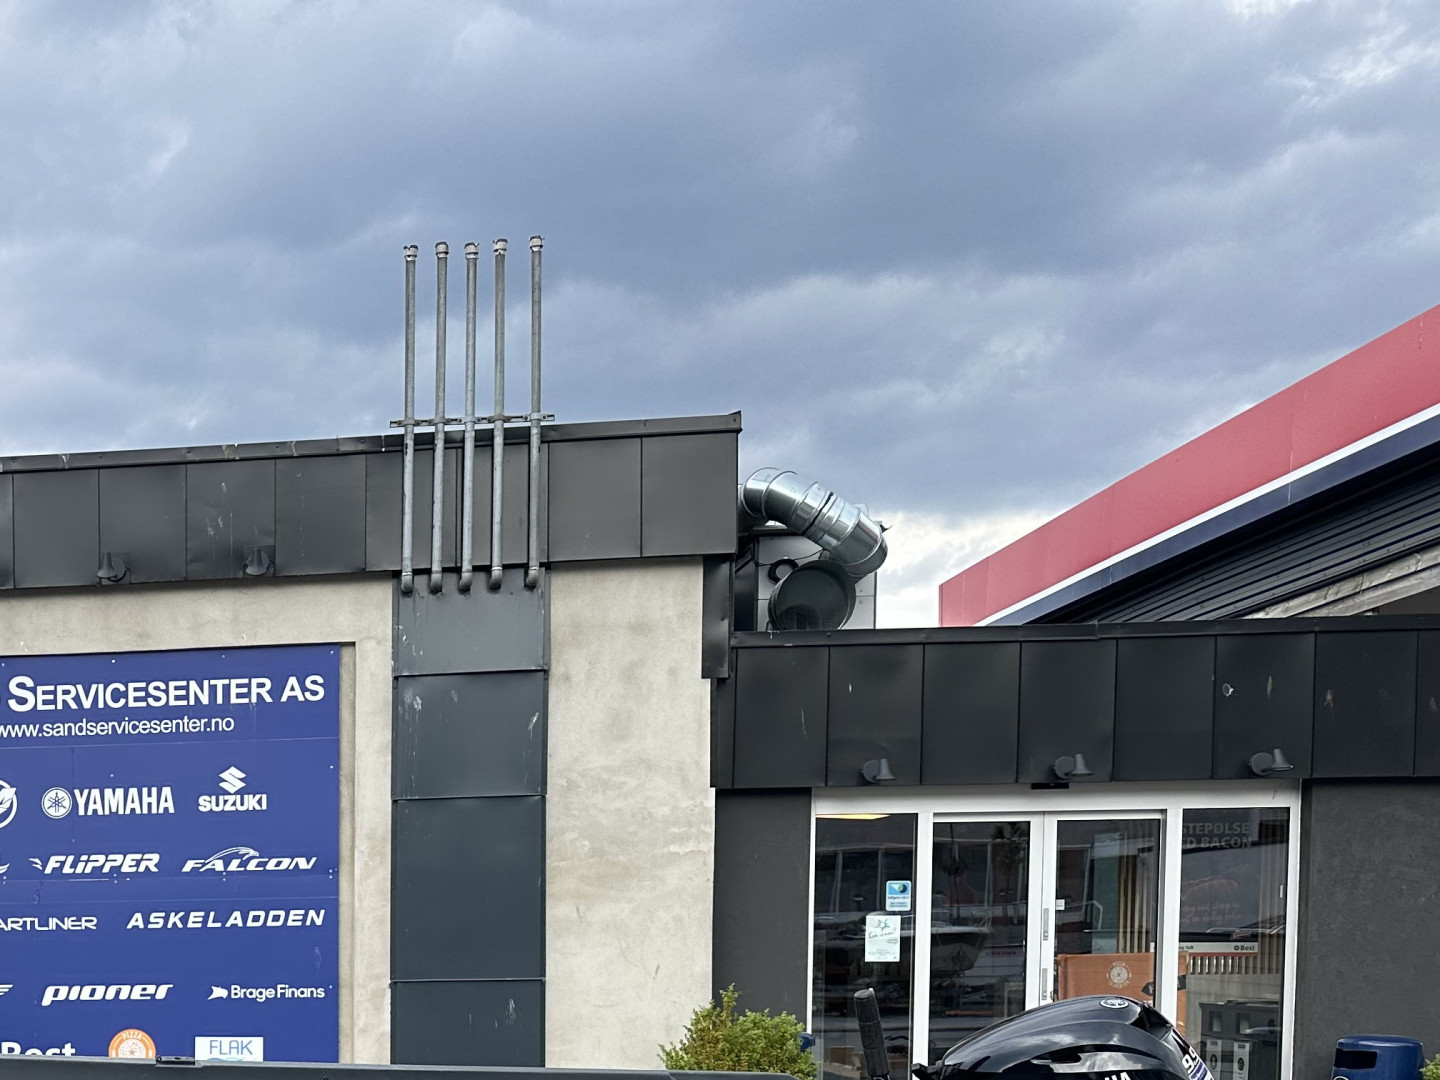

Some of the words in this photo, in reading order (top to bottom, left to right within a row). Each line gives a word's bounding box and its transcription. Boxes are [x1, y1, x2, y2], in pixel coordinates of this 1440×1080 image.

[8, 675, 273, 712] SERVICESENTER
[280, 674, 325, 702] AS
[74, 786, 175, 816] YAMAHA
[198, 793, 267, 812] SUZUKI
[182, 854, 317, 873] FALCON
[126, 909, 325, 929] ASKELADDEN
[41, 984, 174, 1007] pioner
[121, 1031, 142, 1040] PIZZA
[209, 1039, 253, 1056] FLAK
